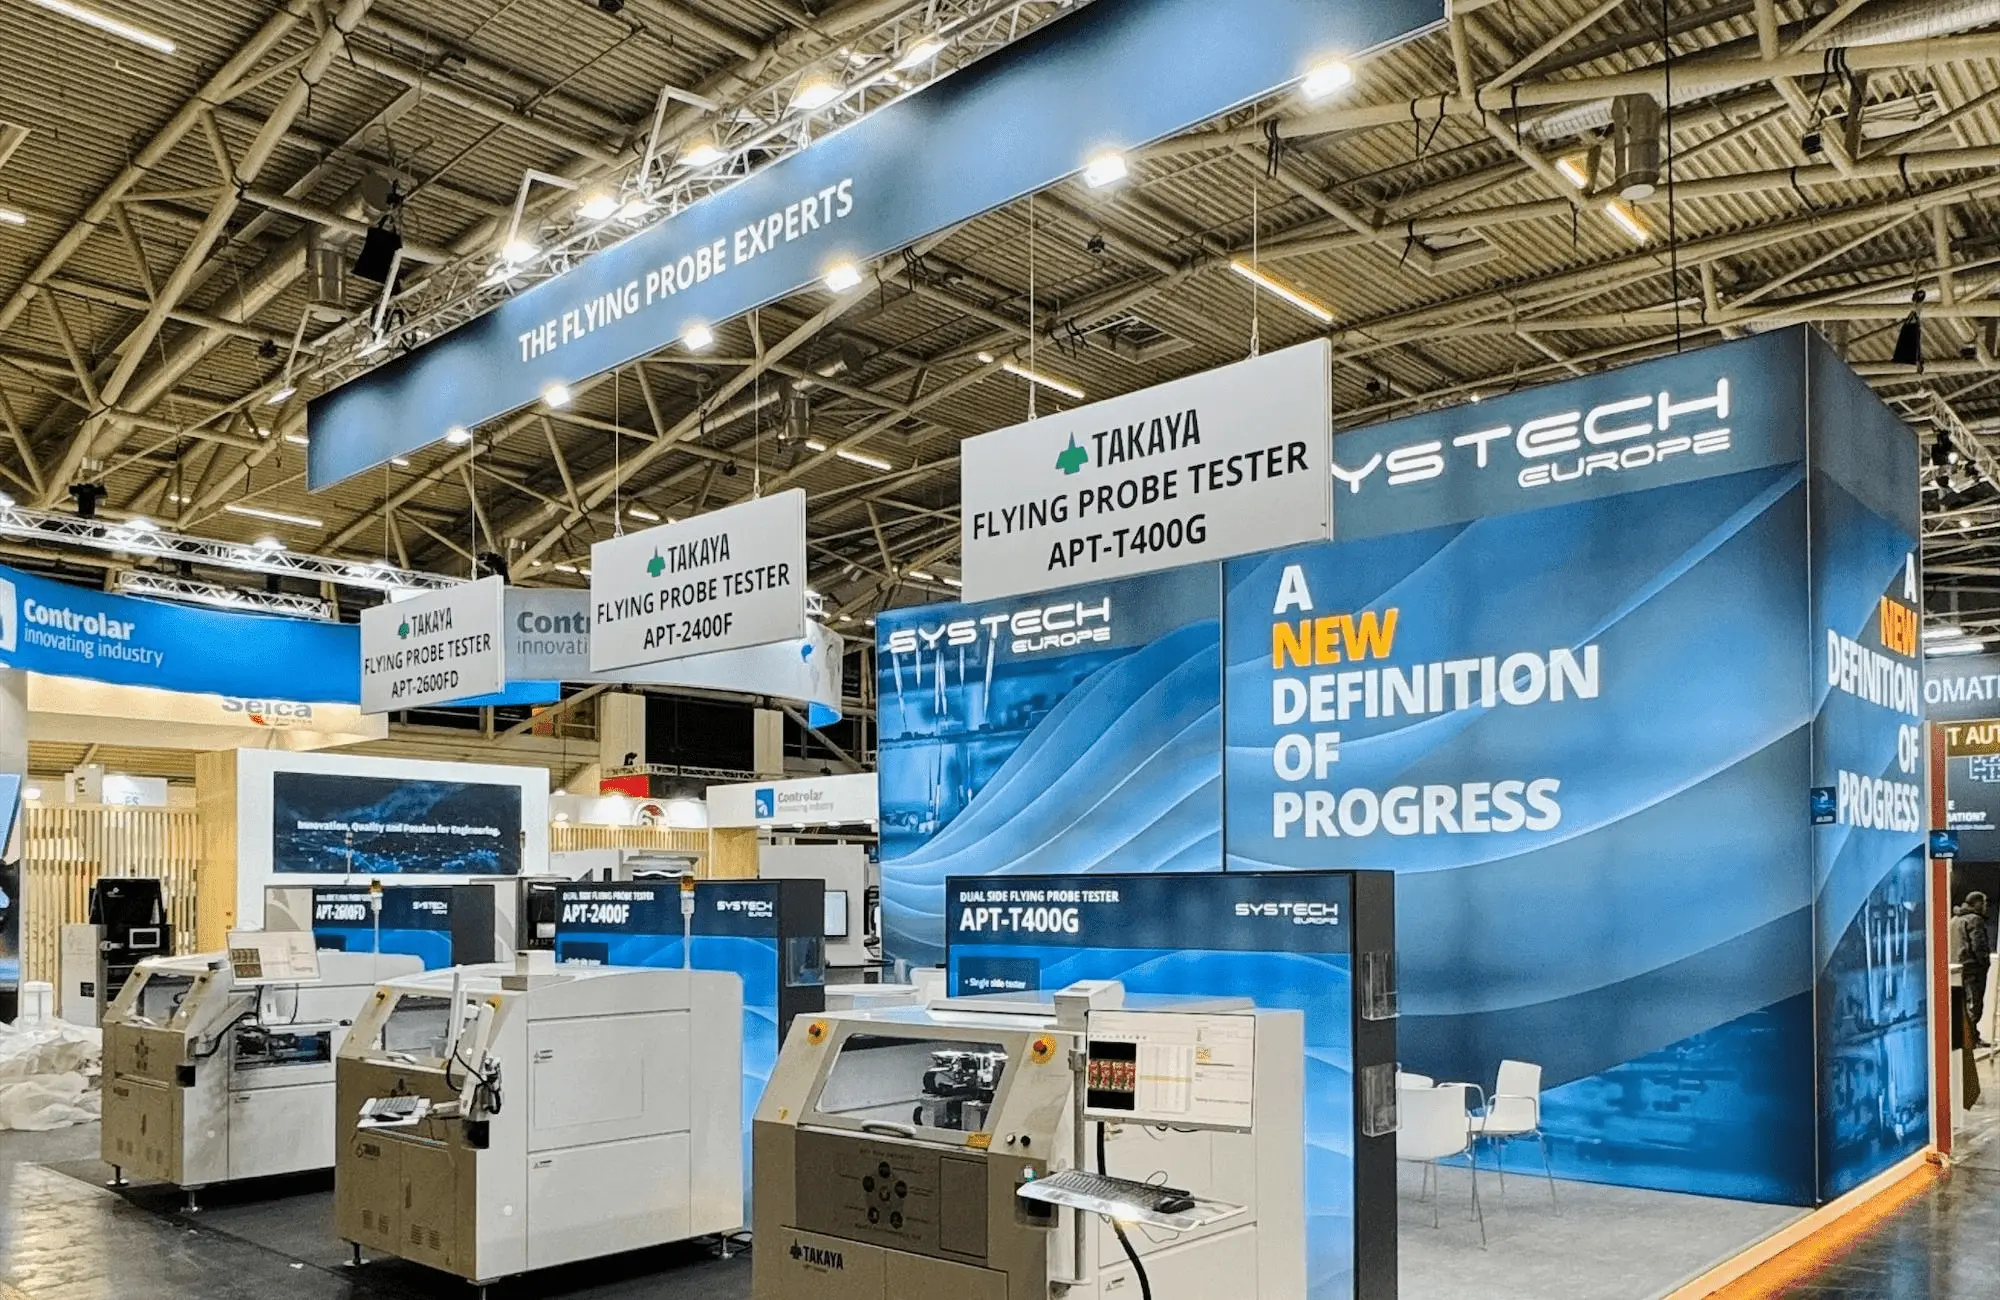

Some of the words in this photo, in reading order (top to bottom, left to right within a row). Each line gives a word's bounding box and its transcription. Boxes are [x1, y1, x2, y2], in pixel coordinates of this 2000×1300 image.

[518, 320, 557, 363] THE
[562, 280, 639, 345] FLYING
[646, 237, 726, 307] PROBE
[733, 178, 853, 266] EXPERTS
[1092, 408, 1201, 468] TAKAYA
[1332, 376, 1730, 495] YSTECH
[1517, 428, 1731, 489] EUROPE
[973, 494, 1068, 540] FLYING
[1079, 469, 1177, 518] PROBE
[1187, 441, 1309, 494] TESTER
[667, 533, 730, 574] TAKAYA
[1047, 513, 1206, 571] APT-T400G
[597, 593, 654, 625] FLYING
[660, 578, 717, 611] PROBE
[723, 563, 790, 597] TESTER
[1272, 564, 1314, 615] A
[1904, 552, 1918, 603] A
[23, 598, 135, 641] Controlar
[412, 607, 453, 638] TAKAYA
[643, 612, 733, 650] APT-2400F
[889, 596, 1110, 654] SYSTECH
[1011, 627, 1111, 654] EUROPE
[1272, 607, 1399, 670] NEW
[1880, 595, 1918, 659] NEW
[24, 623, 94, 659] innovating
[98, 639, 164, 669] industry
[364, 651, 403, 675] FLYING
[407, 643, 444, 667] PROBE
[448, 633, 491, 659] TESTER
[517, 636, 587, 654] innovati
[392, 670, 459, 698] APT-2600FD
[1272, 644, 1599, 726] DEFINITION
[1827, 628, 1919, 717] DEFINITION
[1272, 731, 1341, 781] OF
[1898, 723, 1919, 774] OF
[778, 789, 823, 803] Controlar
[1272, 778, 1561, 839] PROGRESS
[1838, 769, 1919, 834] PROGRESS
[297, 820, 350, 831] Innovation,
[351, 821, 384, 834] Quality
[385, 823, 402, 832] and
[403, 823, 436, 834] Passion
[437, 824, 450, 834] for
[562, 904, 629, 923] APT-2400F
[633, 892, 654, 901] TESTER
[717, 901, 773, 911] SYSTECH
[959, 907, 1079, 933] APT-T400G
[960, 891, 985, 902] DUAL
[987, 891, 1008, 902] SIDE
[1010, 891, 1044, 902] FLYING
[1047, 891, 1080, 902] PROBE
[1082, 891, 1119, 902] TESTER
[1235, 903, 1339, 916] SYSTECH
[803, 1245, 843, 1270] TAKAYA
